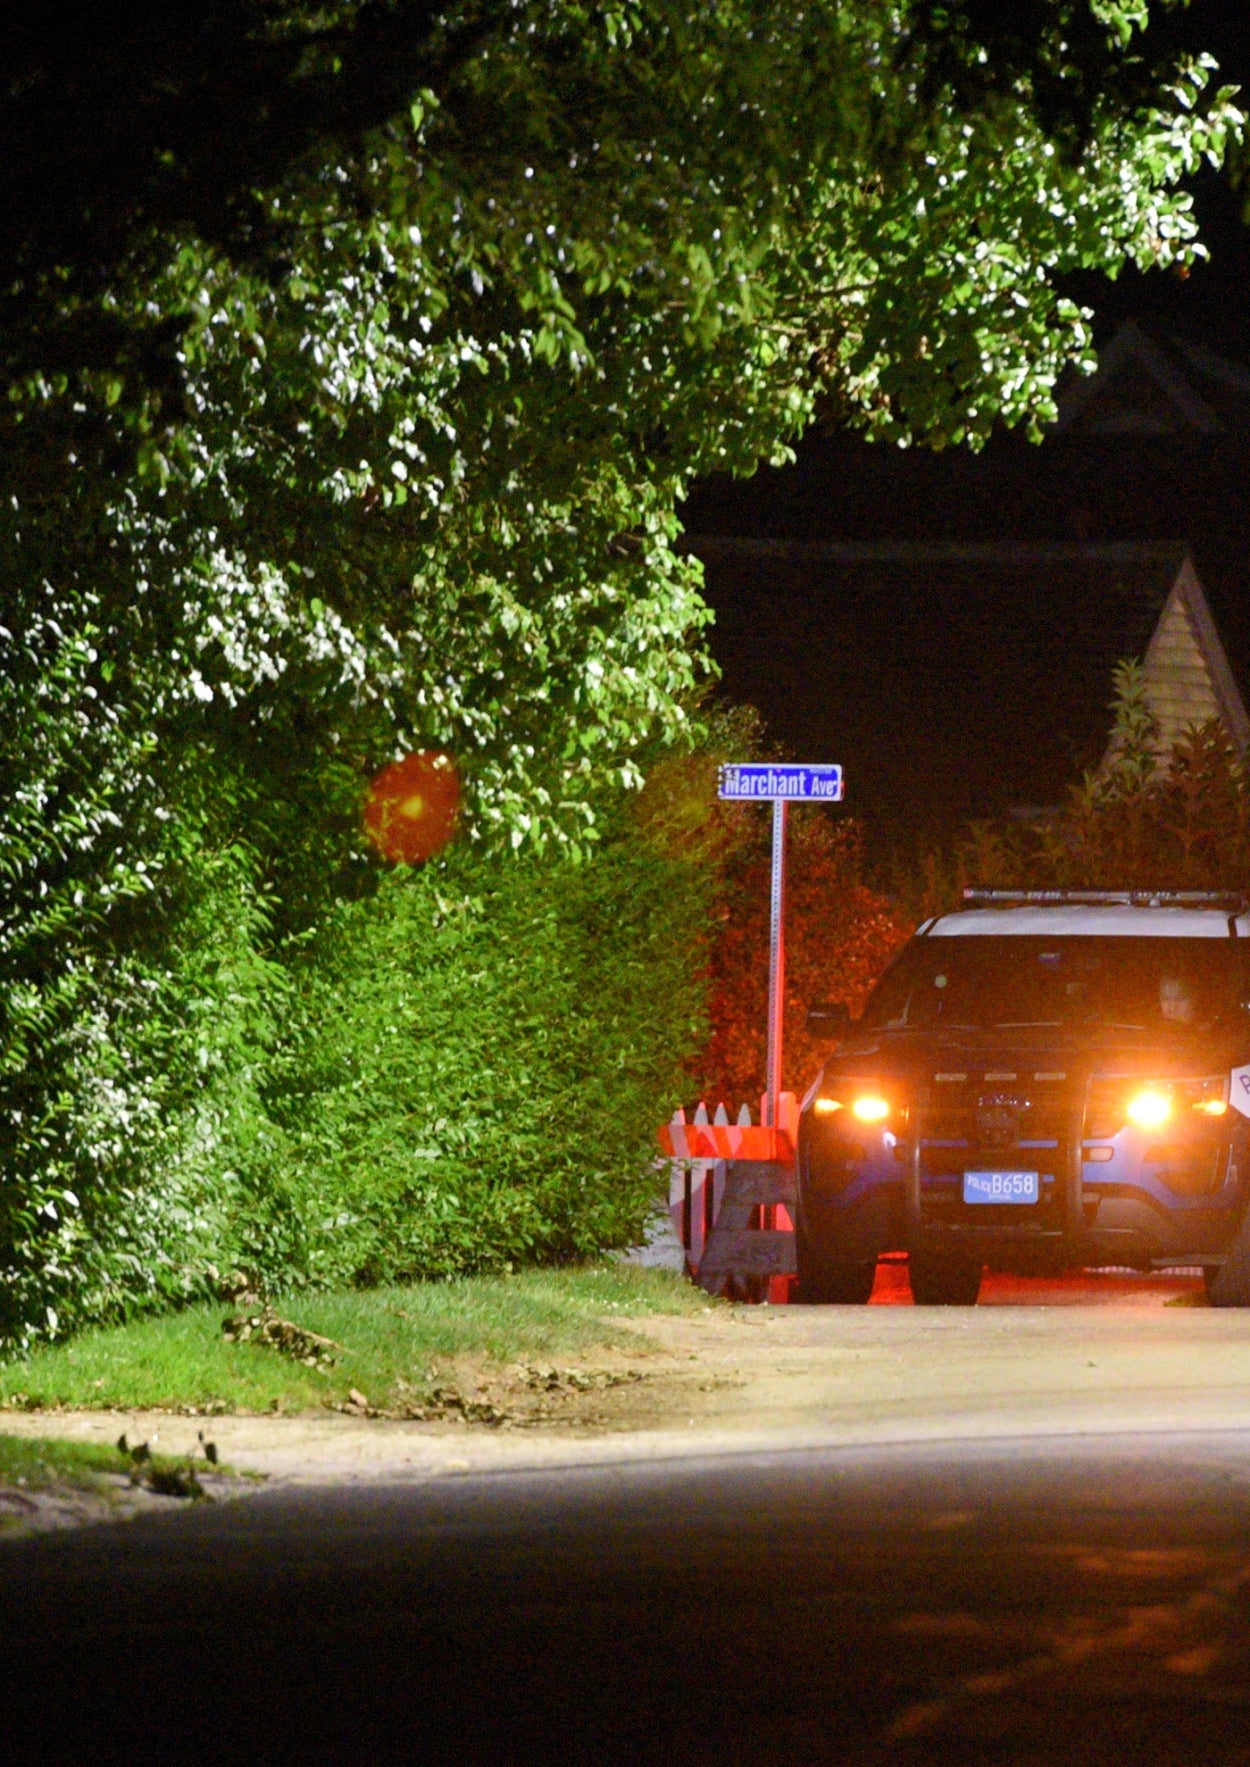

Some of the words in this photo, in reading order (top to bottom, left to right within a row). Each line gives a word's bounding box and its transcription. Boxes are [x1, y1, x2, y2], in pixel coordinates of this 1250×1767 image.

[725, 769, 806, 795] Marchant
[811, 776, 835, 795] Ave
[992, 1174, 1034, 1194] B658
